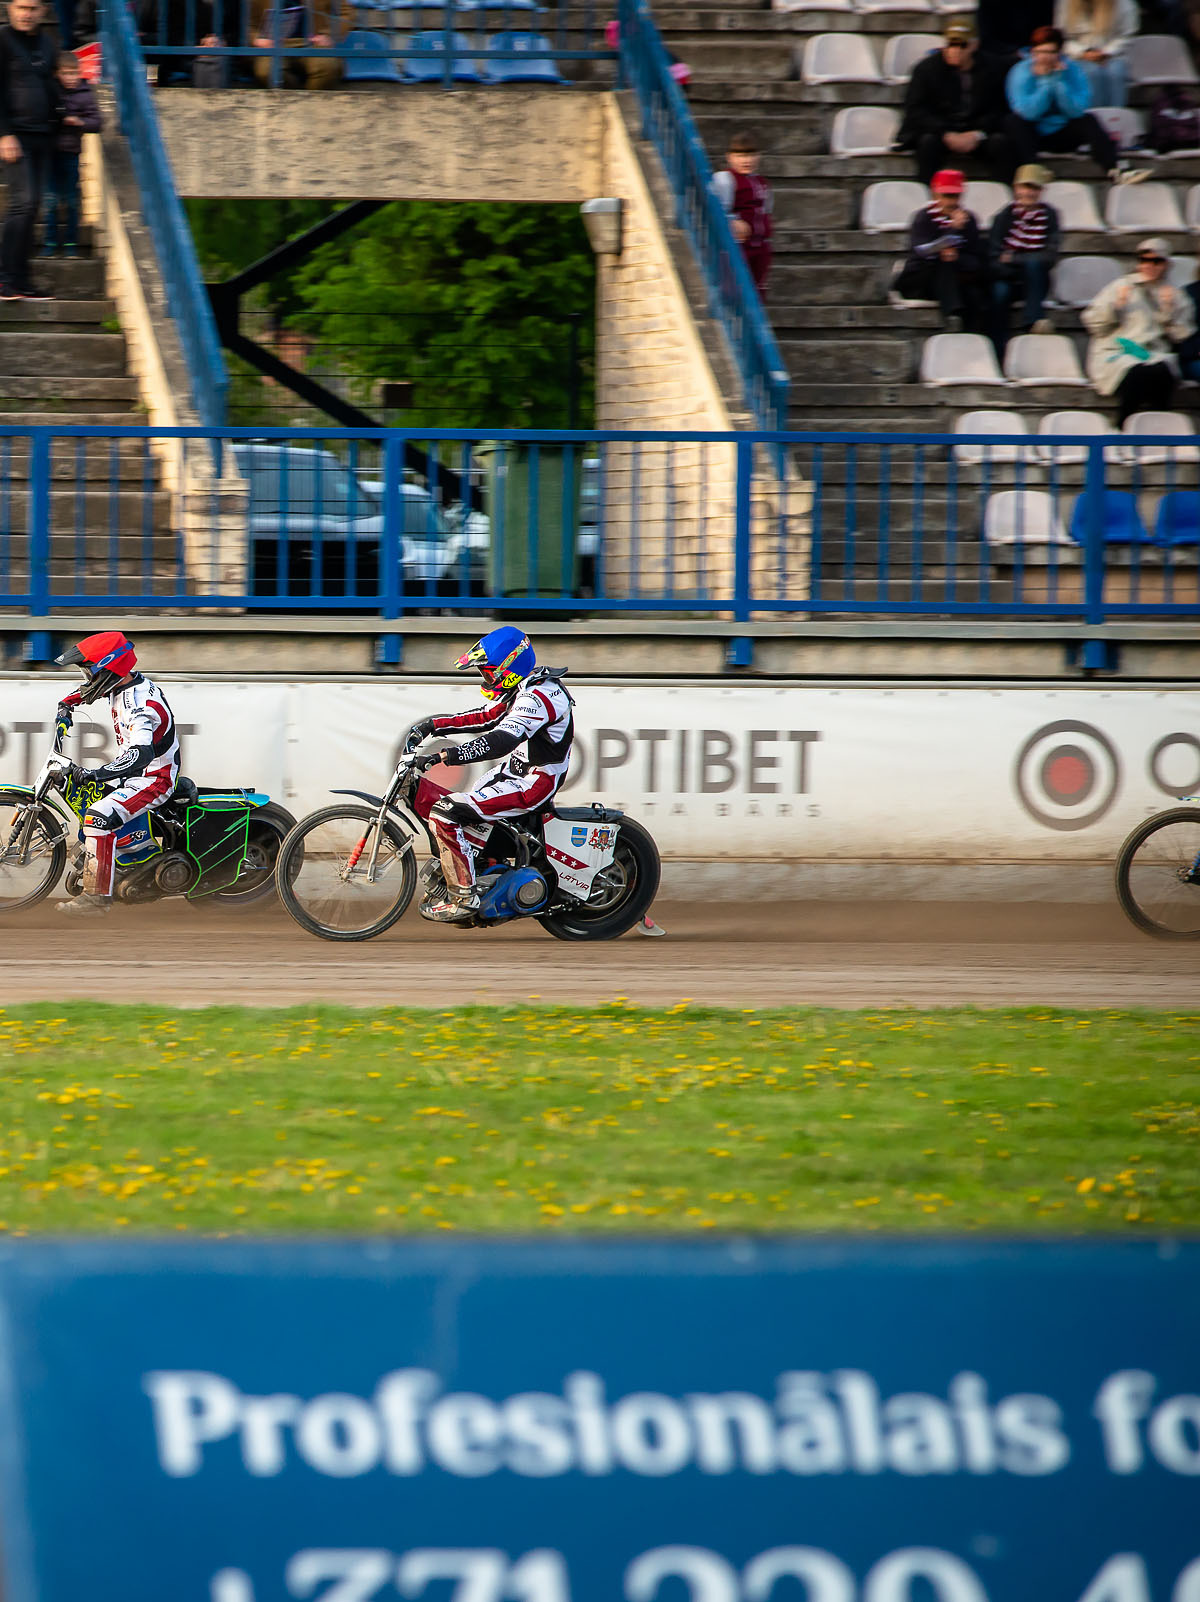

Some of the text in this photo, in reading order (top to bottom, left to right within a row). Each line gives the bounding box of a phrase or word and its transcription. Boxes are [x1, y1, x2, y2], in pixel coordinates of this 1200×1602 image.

[559, 871, 590, 891] LATVIA
[144, 1367, 1200, 1479] Profesionālais fo
